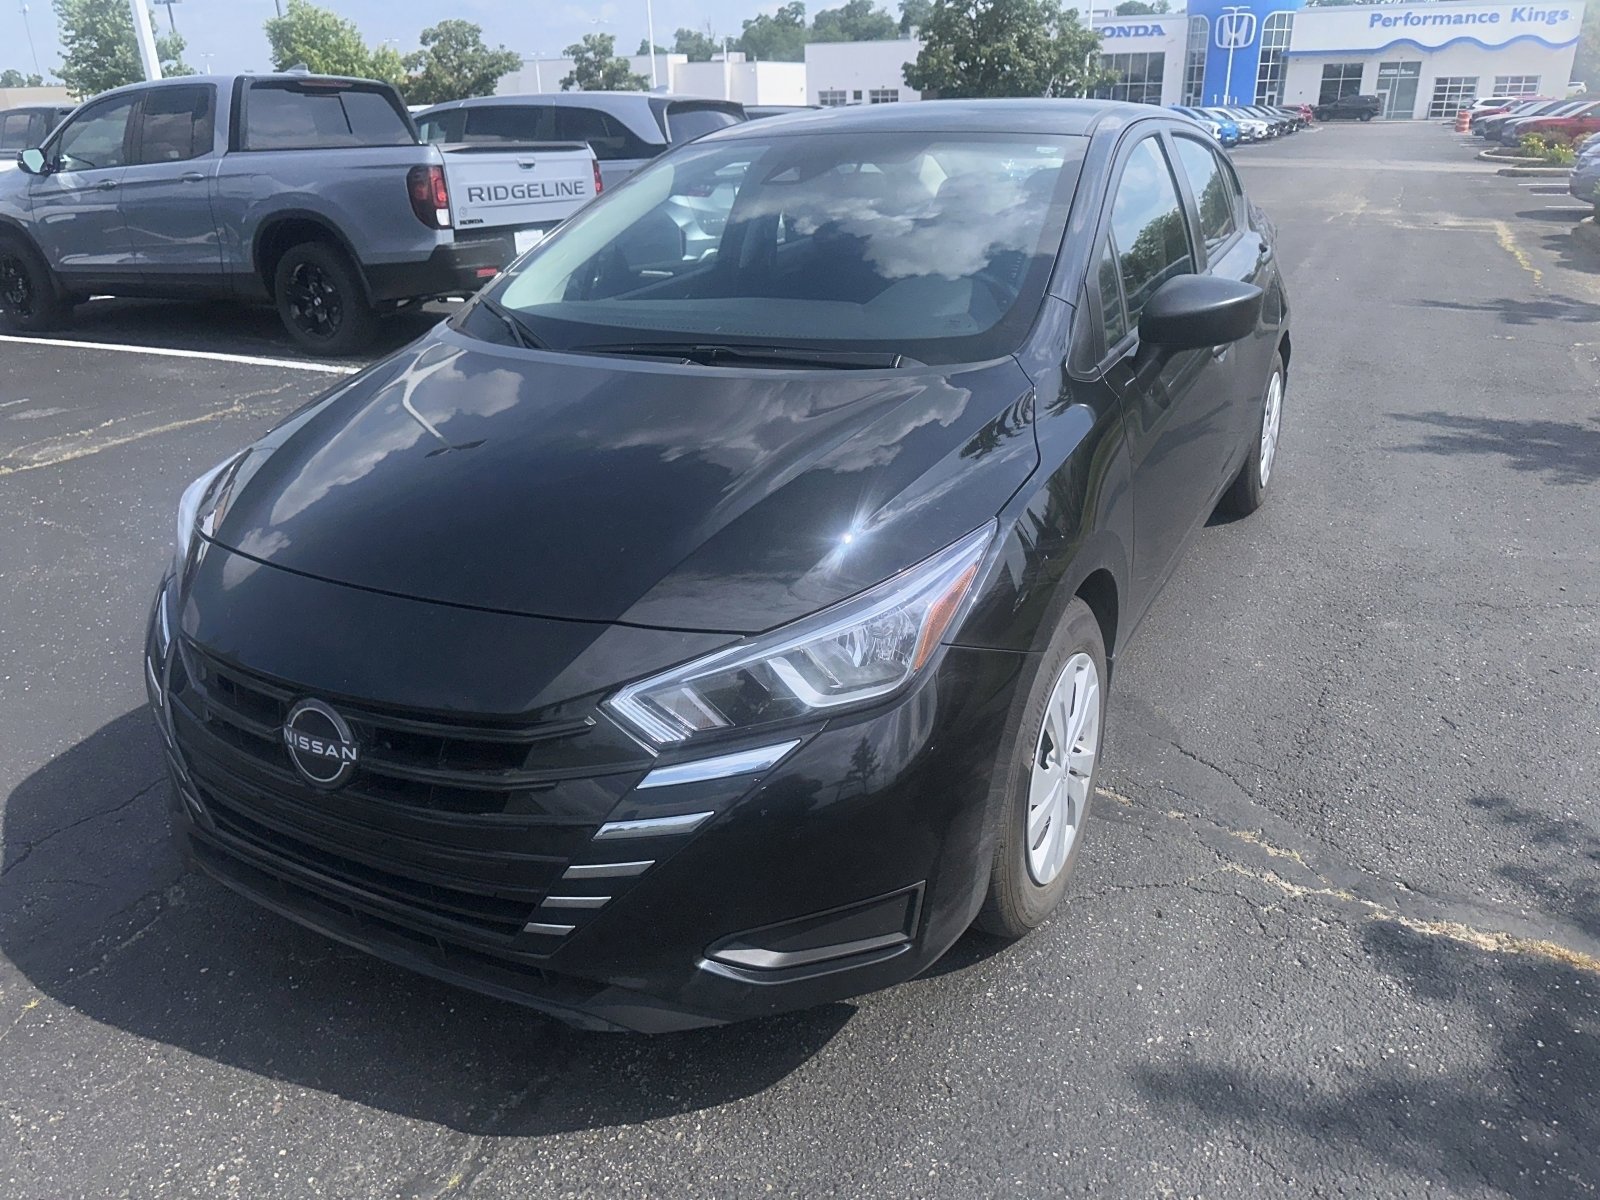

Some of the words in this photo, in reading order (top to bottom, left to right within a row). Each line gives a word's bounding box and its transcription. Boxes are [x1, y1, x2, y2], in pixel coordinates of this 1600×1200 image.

[1369, 11, 1500, 28] Performance
[1510, 7, 1569, 26] Kings
[467, 181, 585, 203] RIDGELINE
[459, 218, 484, 226] HONDA
[283, 727, 357, 761] NISSAN
